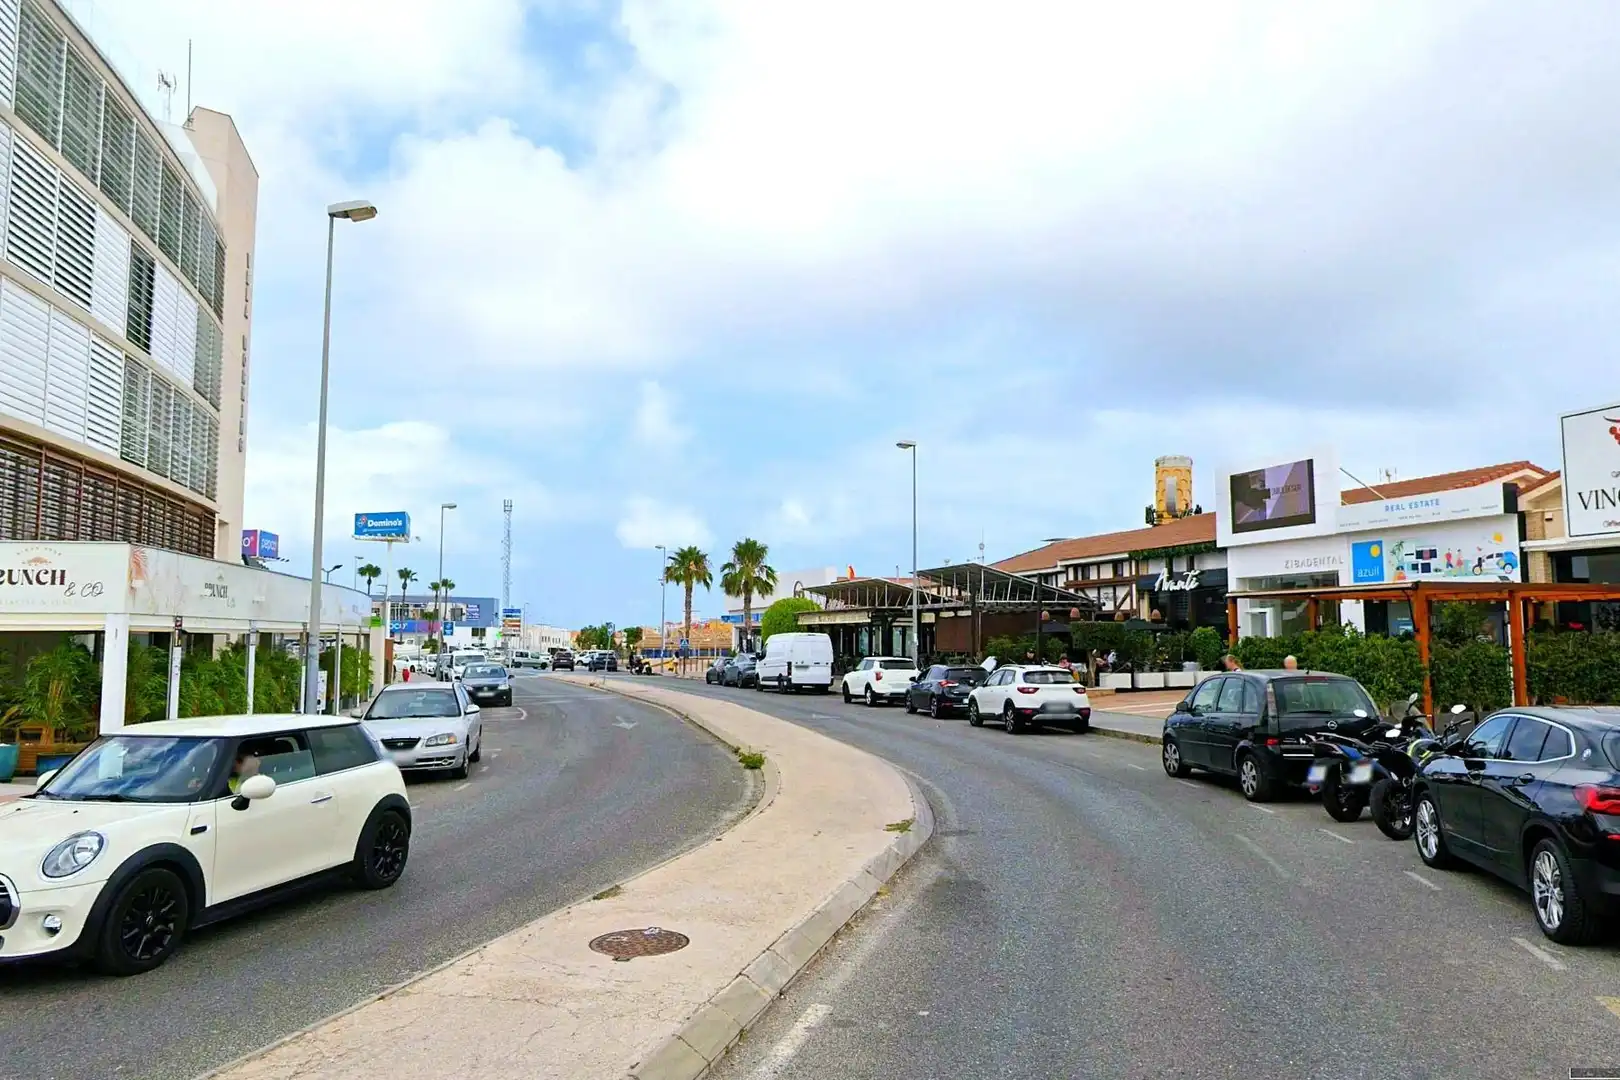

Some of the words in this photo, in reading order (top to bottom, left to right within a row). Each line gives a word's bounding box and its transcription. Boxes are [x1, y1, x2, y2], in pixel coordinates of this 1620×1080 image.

[1384, 503, 1405, 512] REAL
[1408, 498, 1440, 510] ESTATE
[1577, 487, 1620, 511] VIN
[367, 517, 403, 528] Domino's
[1284, 554, 1344, 569] ZIBADENTAL
[64, 581, 76, 597] &
